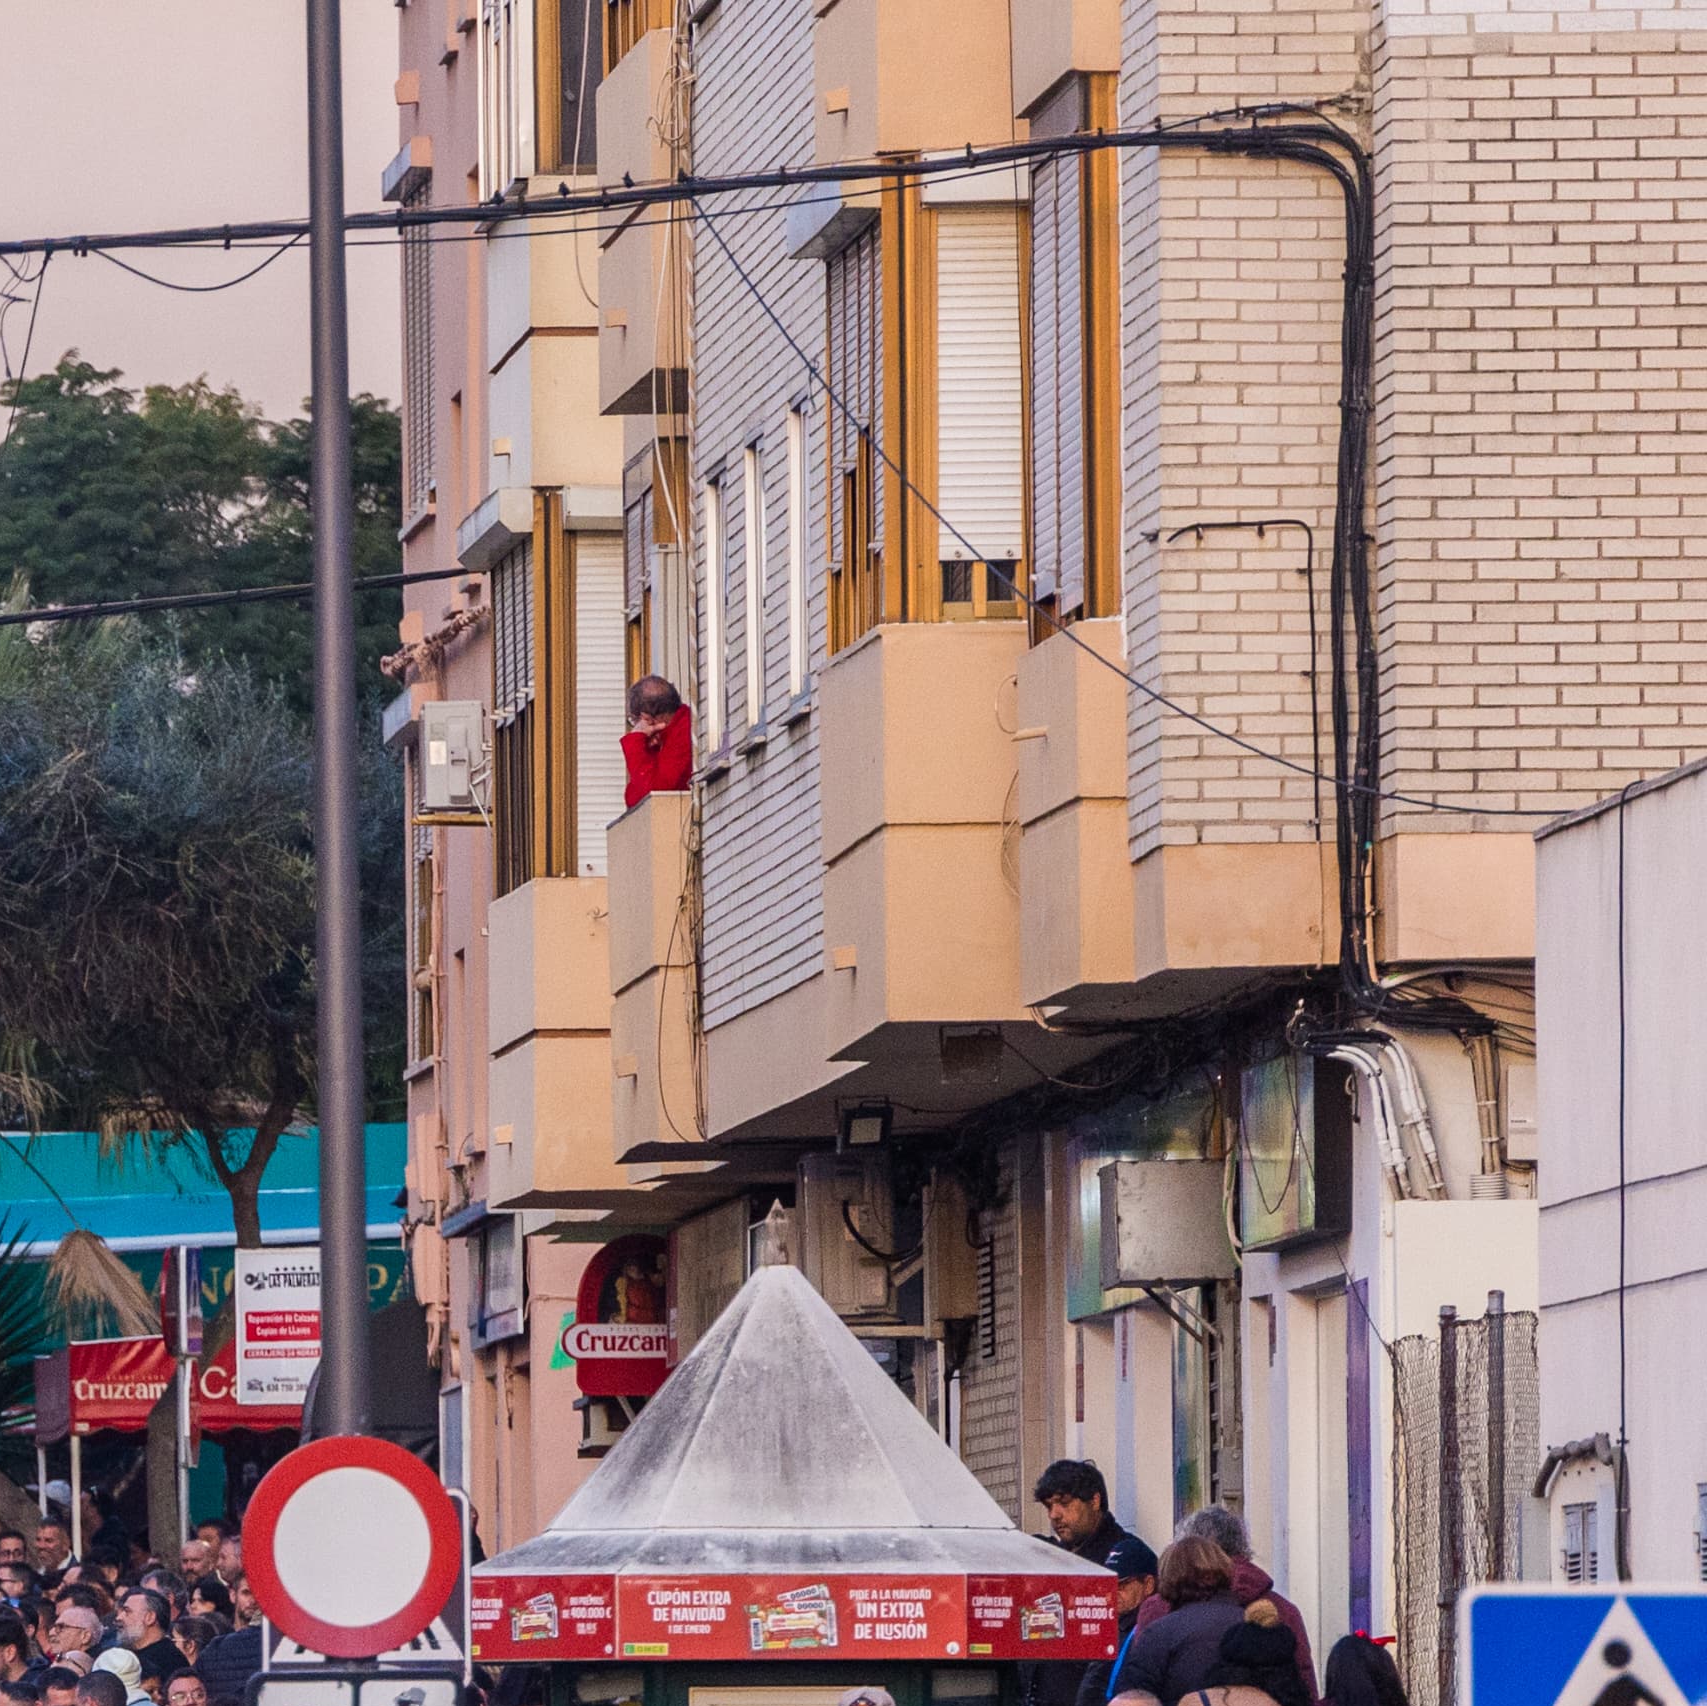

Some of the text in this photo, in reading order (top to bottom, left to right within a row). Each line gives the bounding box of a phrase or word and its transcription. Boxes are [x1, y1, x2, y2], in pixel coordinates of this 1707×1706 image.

[74, 1378, 168, 1401] Cruzcam
[647, 1588, 732, 1607] CUPÓN EXTRA
[849, 1589, 869, 1600] PIDE
[871, 1589, 878, 1600] A
[892, 1589, 932, 1600] NAVIDAD
[653, 1606, 726, 1623] DE NAVIDAD
[857, 1602, 925, 1619] UN EXTRA
[854, 1624, 872, 1640] DE
